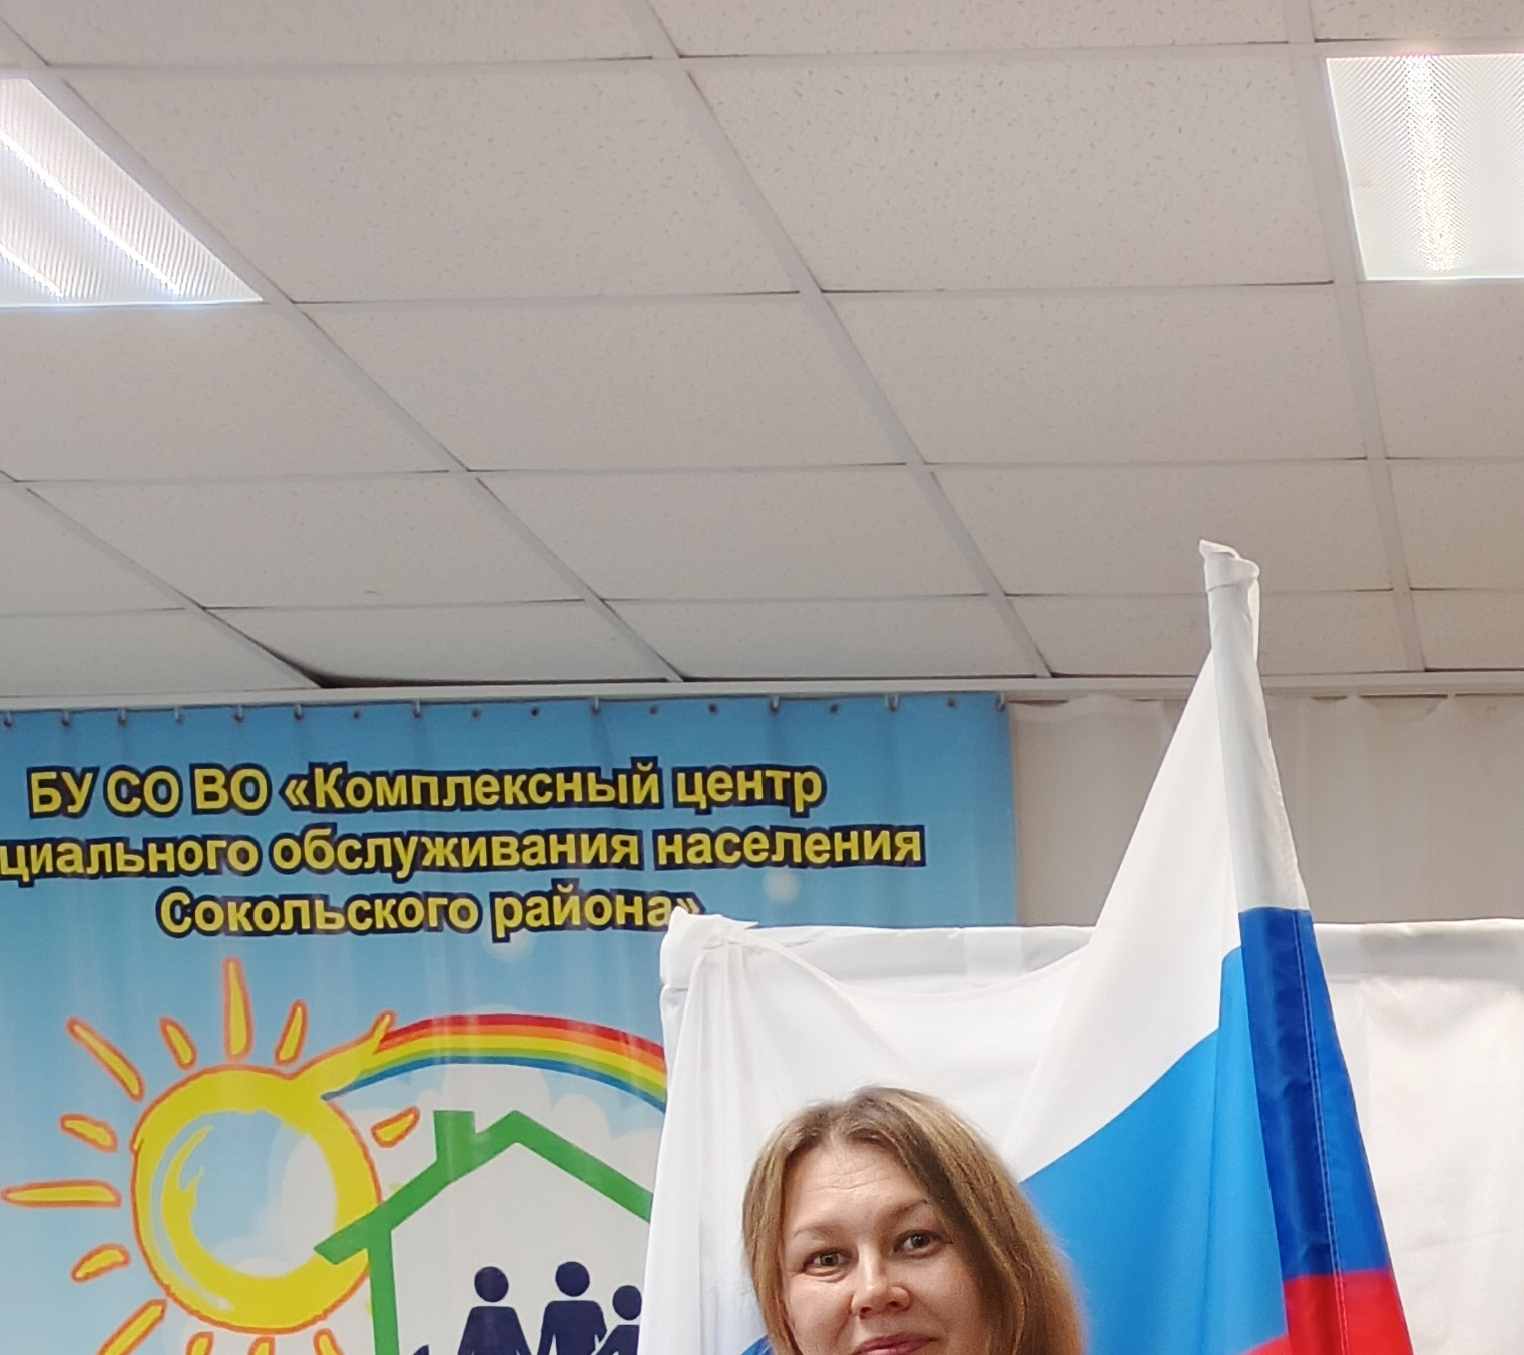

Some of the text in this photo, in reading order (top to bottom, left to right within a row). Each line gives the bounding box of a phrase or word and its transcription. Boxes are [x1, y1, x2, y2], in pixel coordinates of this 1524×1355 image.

[29, 761, 823, 814] БУ СО ВО «Комплексный центр
[0, 827, 922, 882] циального обслуживания населения
[159, 891, 479, 934] Сокольского
